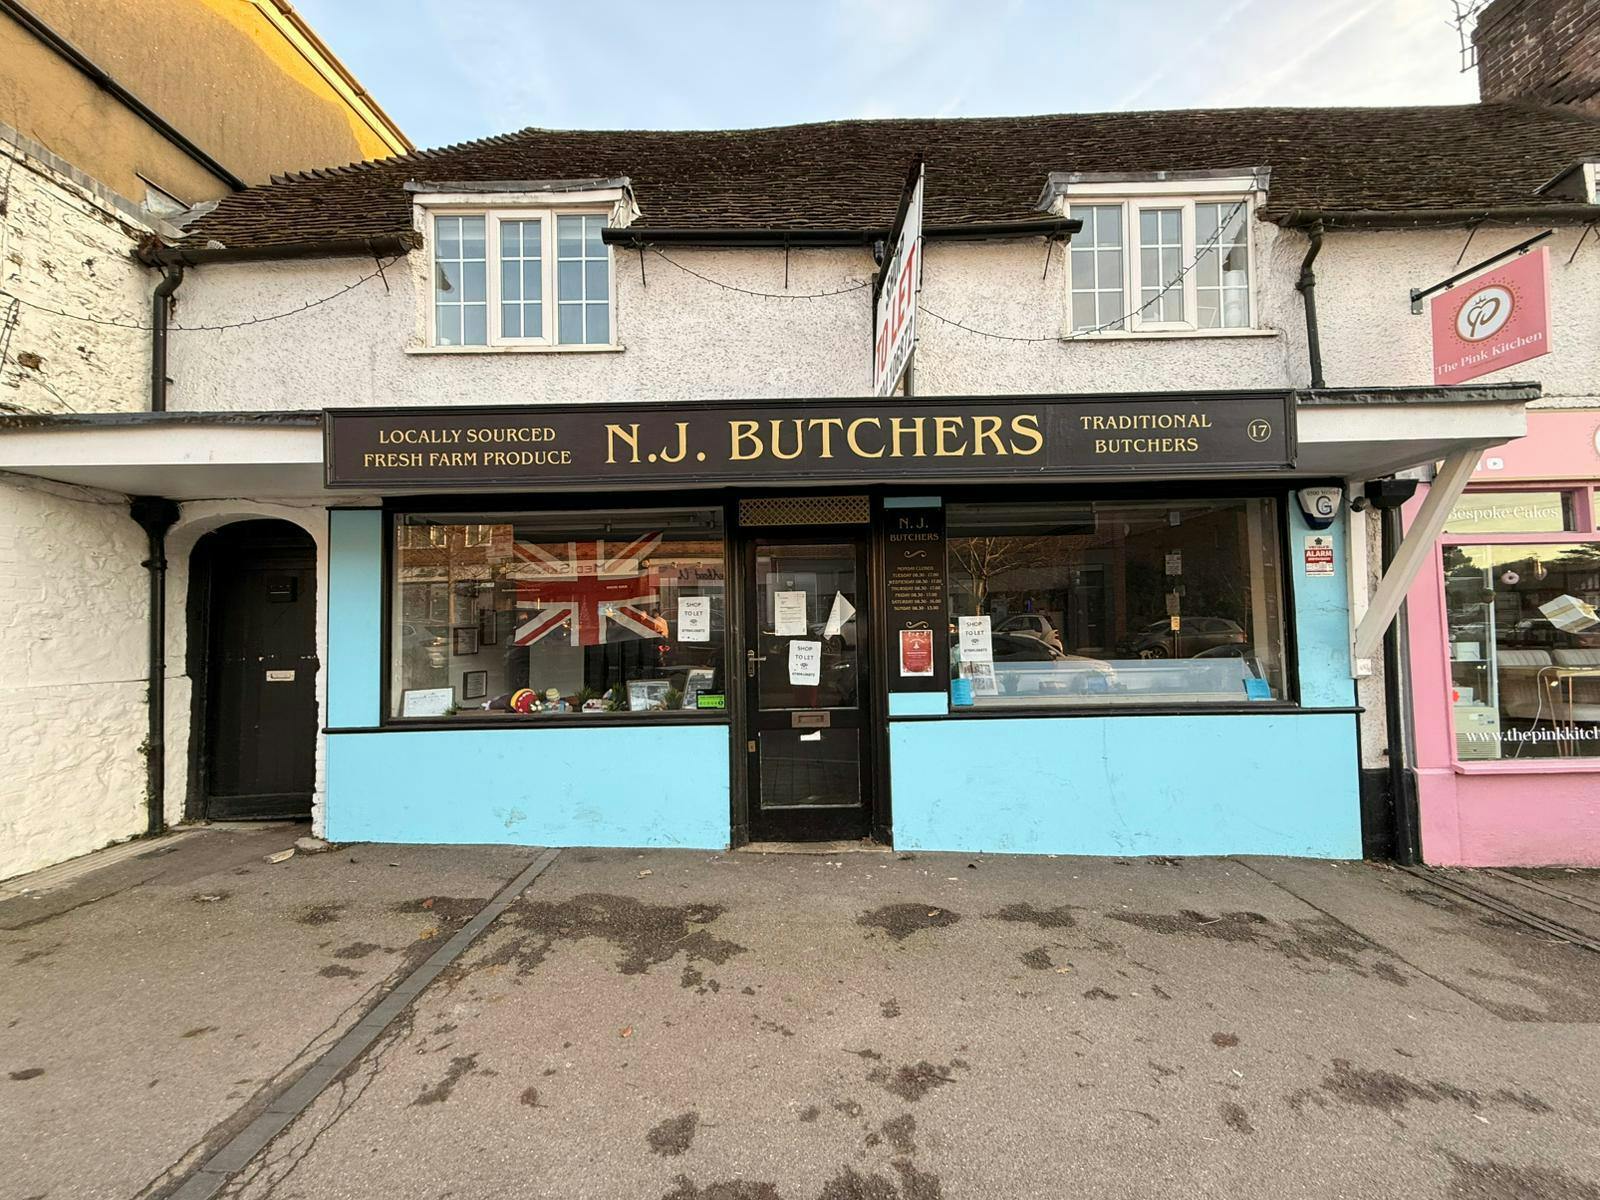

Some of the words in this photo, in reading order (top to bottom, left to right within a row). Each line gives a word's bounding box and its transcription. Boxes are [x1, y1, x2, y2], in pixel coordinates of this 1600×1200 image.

[891, 239, 916, 348] LET
[1435, 361, 1459, 376] The
[1460, 350, 1489, 367] Pink
[1491, 330, 1543, 357] Kitchen
[1080, 414, 1213, 430] TRADITIONAL
[379, 429, 462, 444] LOCALLY
[466, 427, 556, 443] SOURCED
[604, 421, 706, 464] N.J.
[728, 414, 1045, 461] BUTCHERS
[1251, 424, 1268, 438] 17
[1095, 437, 1199, 454] BUTCHERS
[364, 453, 423, 468] FRESH
[428, 452, 478, 466] FARM
[483, 450, 572, 466] PRODUCE
[1449, 506, 1509, 522] Bespoke
[1513, 504, 1559, 519] Cakes
[890, 533, 940, 542] BUTCHERS
